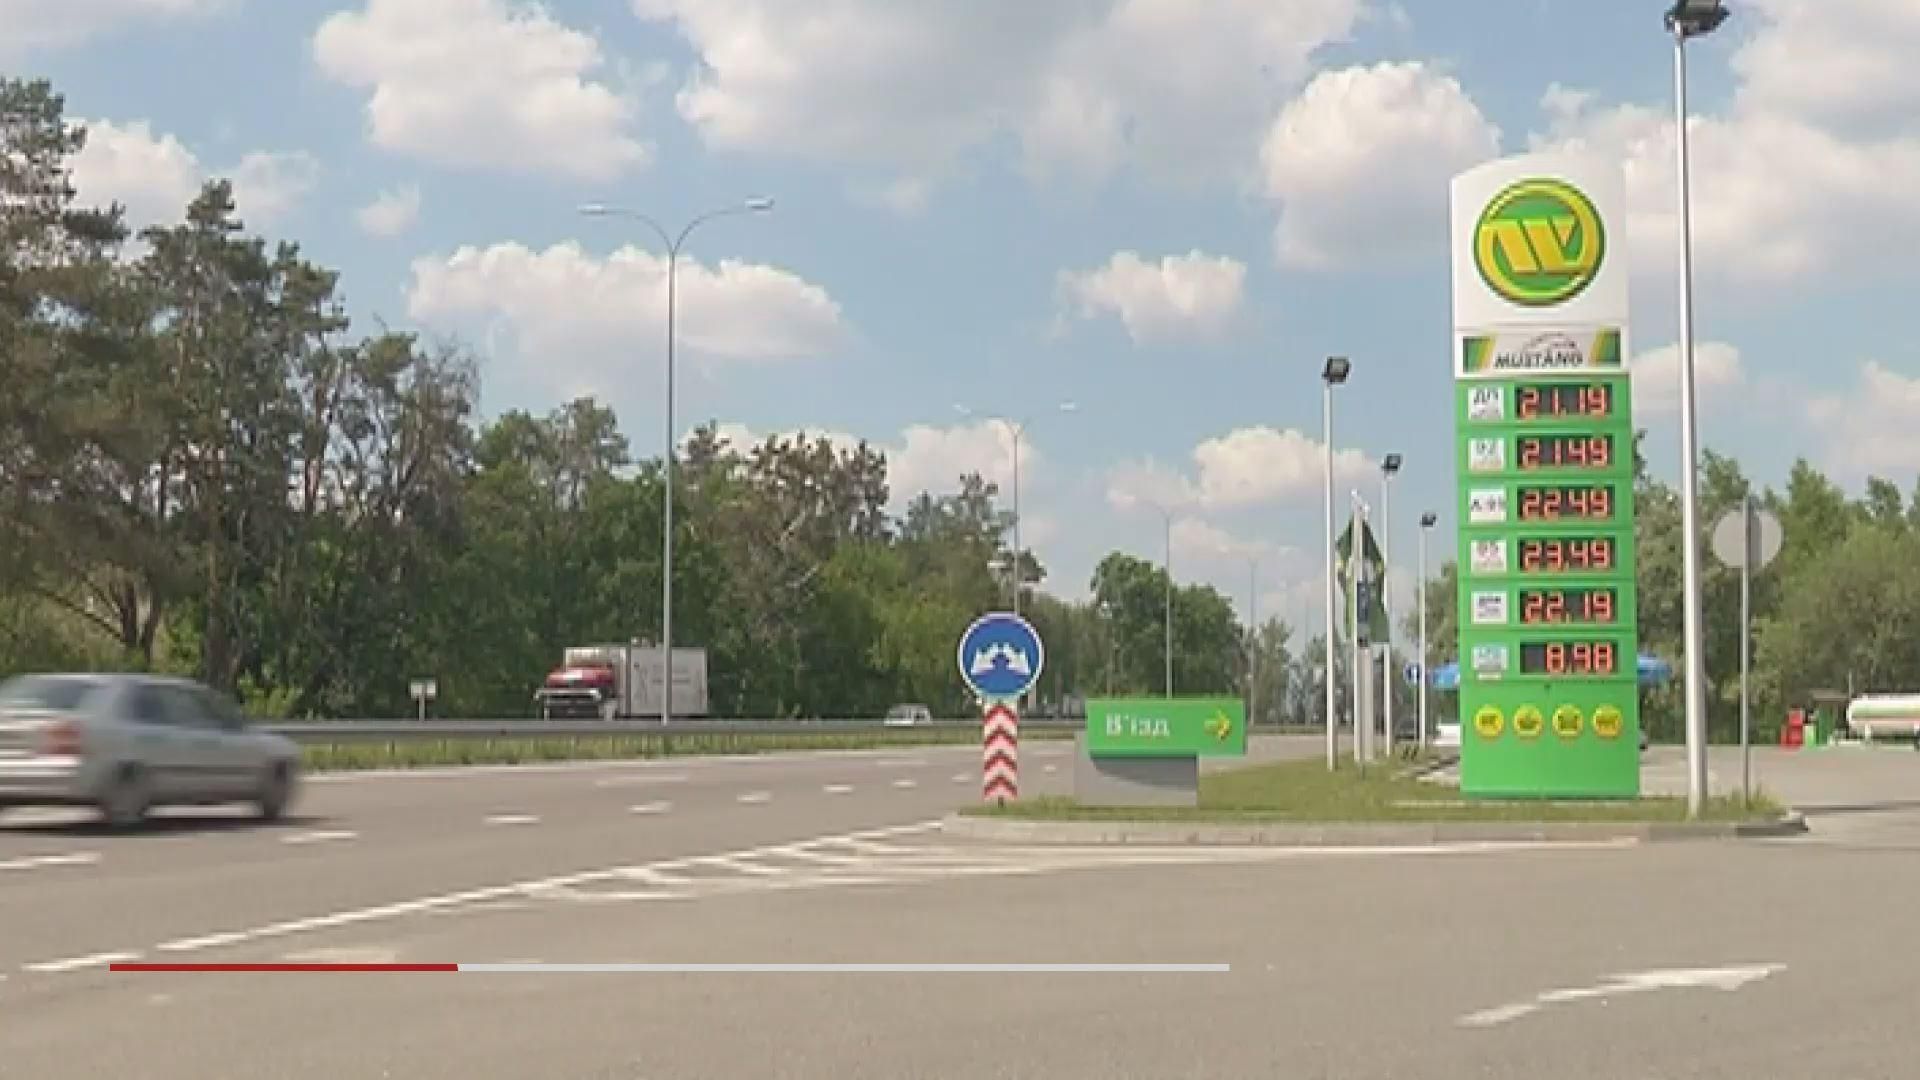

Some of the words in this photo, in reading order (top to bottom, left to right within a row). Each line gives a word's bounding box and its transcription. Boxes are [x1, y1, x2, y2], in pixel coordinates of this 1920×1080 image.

[1521, 386, 1607, 418] 21.19
[1524, 539, 1610, 572] 23.49
[1525, 591, 1611, 623] 22.19
[1546, 642, 1613, 674] 8.98
